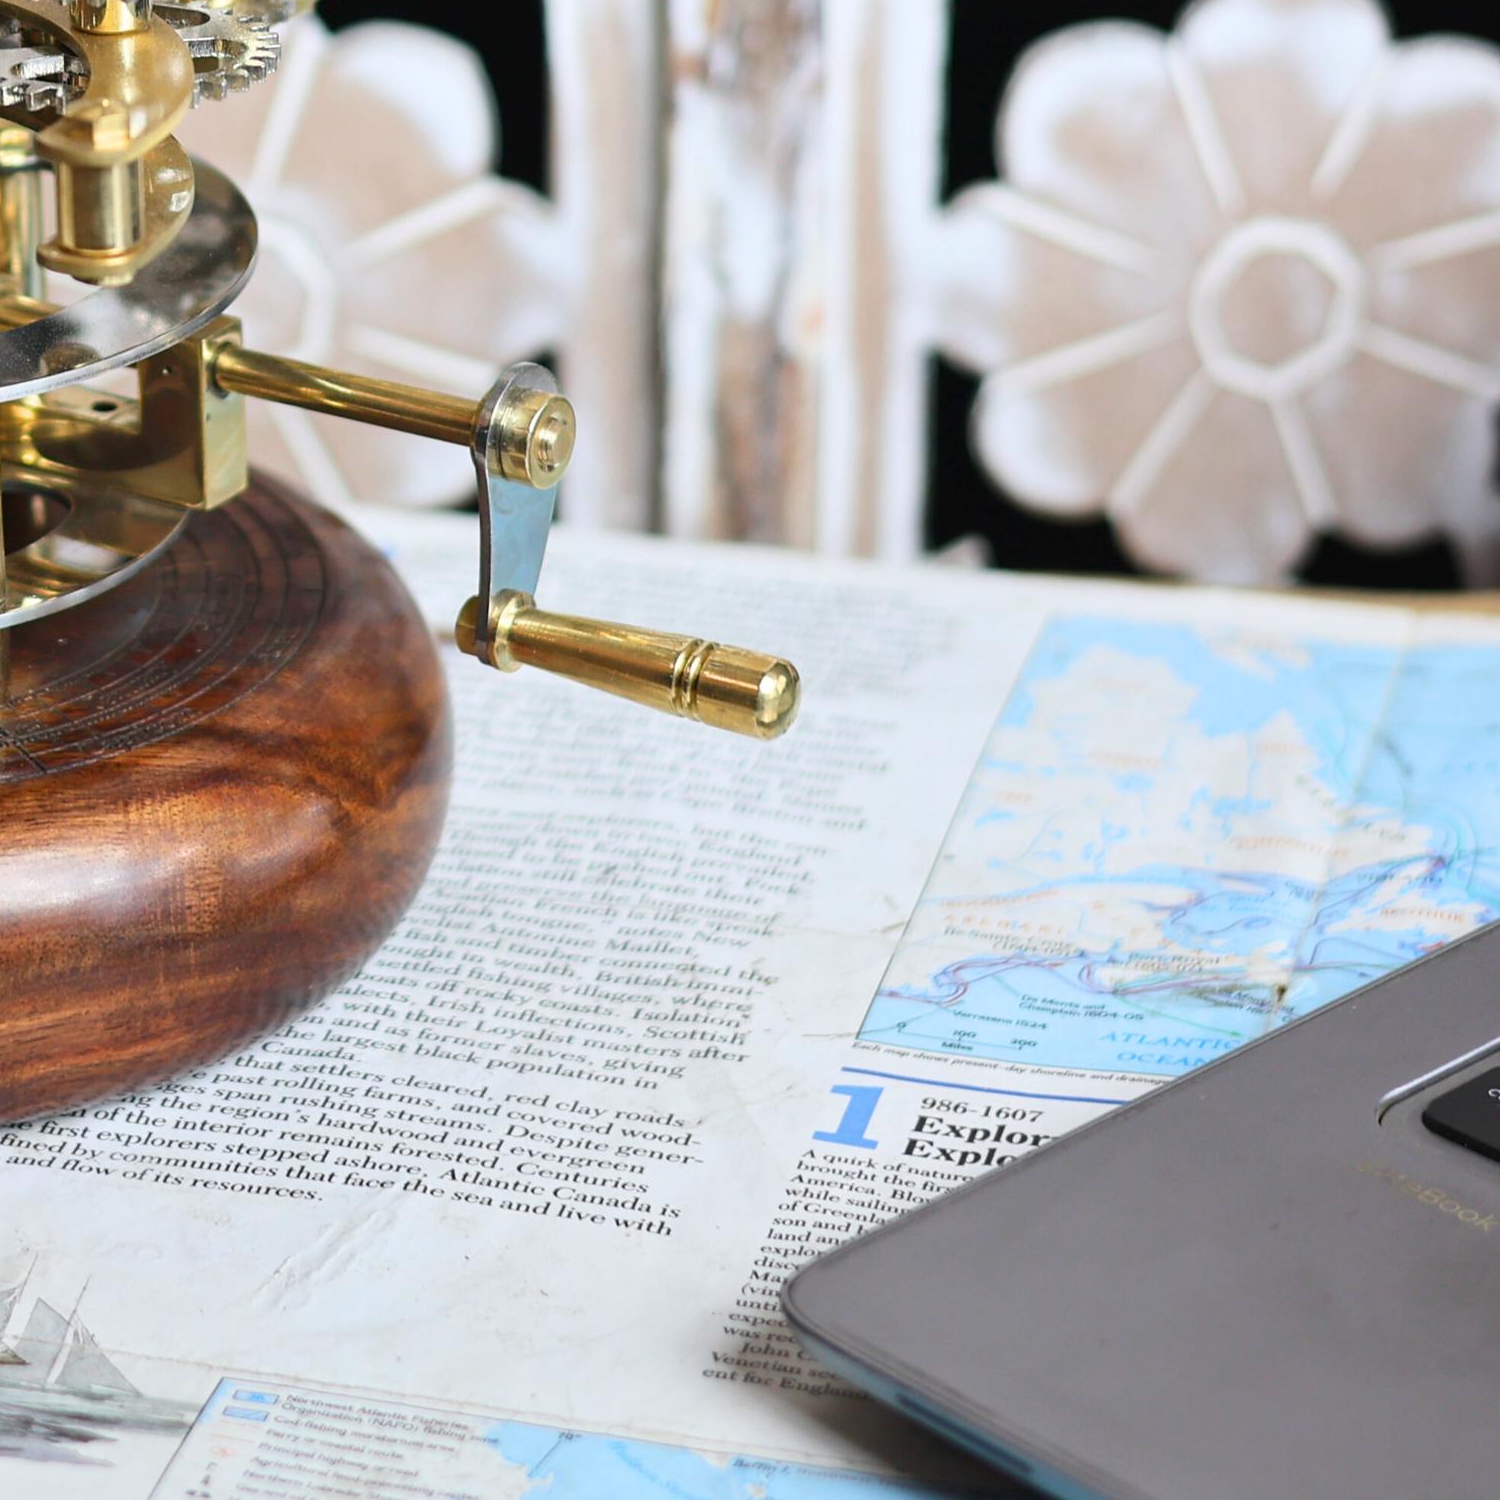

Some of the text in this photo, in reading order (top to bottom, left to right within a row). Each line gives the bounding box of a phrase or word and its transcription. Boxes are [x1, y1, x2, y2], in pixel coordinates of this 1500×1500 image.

[261, 1040, 361, 1062] Canada.
[852, 1041, 882, 1054] Each
[884, 1047, 910, 1059] map
[914, 1052, 949, 1065] shows
[1030, 1067, 1086, 1078] shoreline
[1090, 1074, 1114, 1082] and
[212, 1071, 702, 1146] past rolling farms, and covered wood-
[234, 1055, 686, 1129] that settlers cleared, red clay roads
[921, 1097, 1044, 1122] 986-1607
[160, 1096, 646, 1175] the region's hardwood and evergreen
[214, 1088, 704, 1166] span rushing streams. Despite gener-
[812, 1085, 884, 1150] 1
[912, 1115, 1056, 1148] Explor
[95, 1108, 649, 1194] of the interior remains forested. Centuries
[802, 1150, 975, 1182] A quirk of nature
[6, 1155, 53, 1169] and
[60, 1158, 118, 1176] flow
[122, 1167, 154, 1182] of
[154, 1171, 184, 1186] its
[191, 1176, 324, 1201] resources.
[40, 1121, 682, 1220] first explorers stepped ashore, Atlantic Canada is
[72, 1141, 100, 1161] by
[109, 1149, 278, 1180] communities
[285, 1164, 337, 1184] that
[343, 1170, 396, 1190] face
[402, 1179, 445, 1198] the
[451, 1188, 494, 1207] sea
[500, 1198, 549, 1216] and
[557, 1204, 606, 1225] live
[613, 1215, 673, 1237] with
[790, 1174, 881, 1196] America.
[797, 1161, 916, 1188] brought the
[778, 1201, 802, 1212] of
[785, 1188, 840, 1204] while
[767, 1229, 810, 1244] land
[772, 1216, 850, 1234] son and
